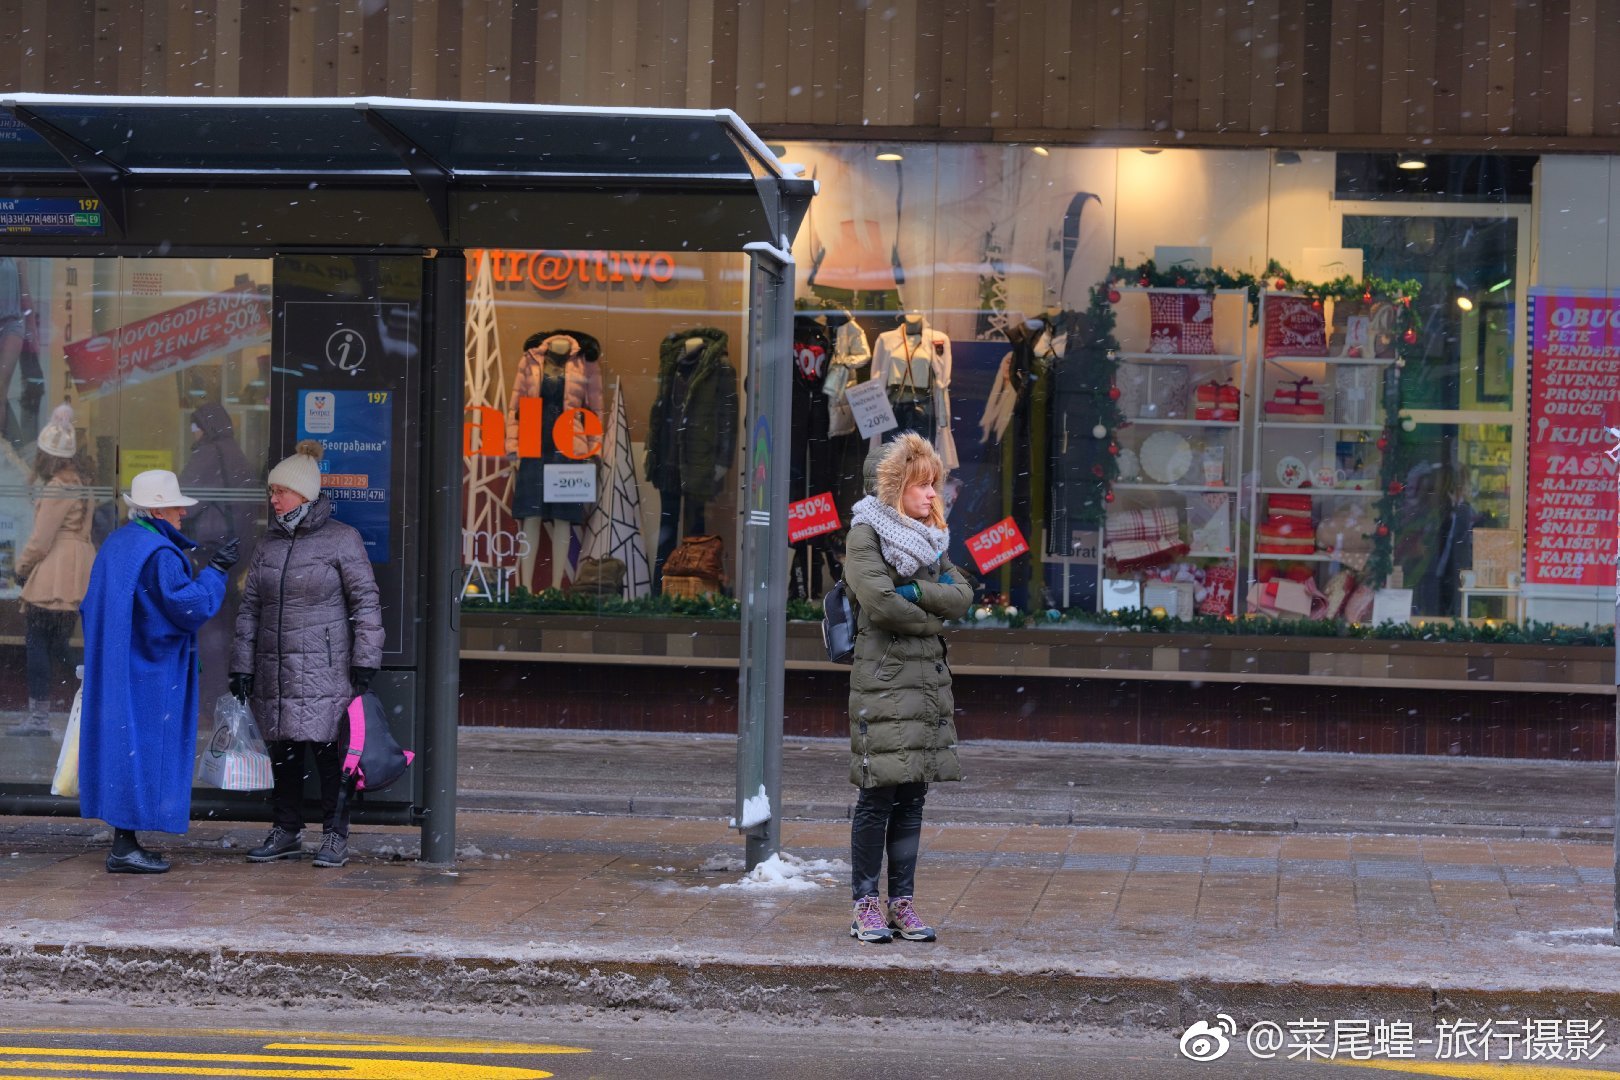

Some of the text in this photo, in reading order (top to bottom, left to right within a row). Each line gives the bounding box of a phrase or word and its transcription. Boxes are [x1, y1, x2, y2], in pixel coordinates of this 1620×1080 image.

[79, 200, 98, 210] 197
[25, 214, 40, 224] 47H
[119, 325, 211, 370] SNIŽENJE
[367, 392, 388, 404] 197
[1540, 386, 1620, 402] -PROŠIRI
[863, 412, 890, 428] -20%
[463, 397, 603, 460] ale
[552, 478, 591, 488] -20%
[334, 489, 350, 499] 31H
[351, 490, 367, 499] 33H
[368, 490, 384, 500] 47H
